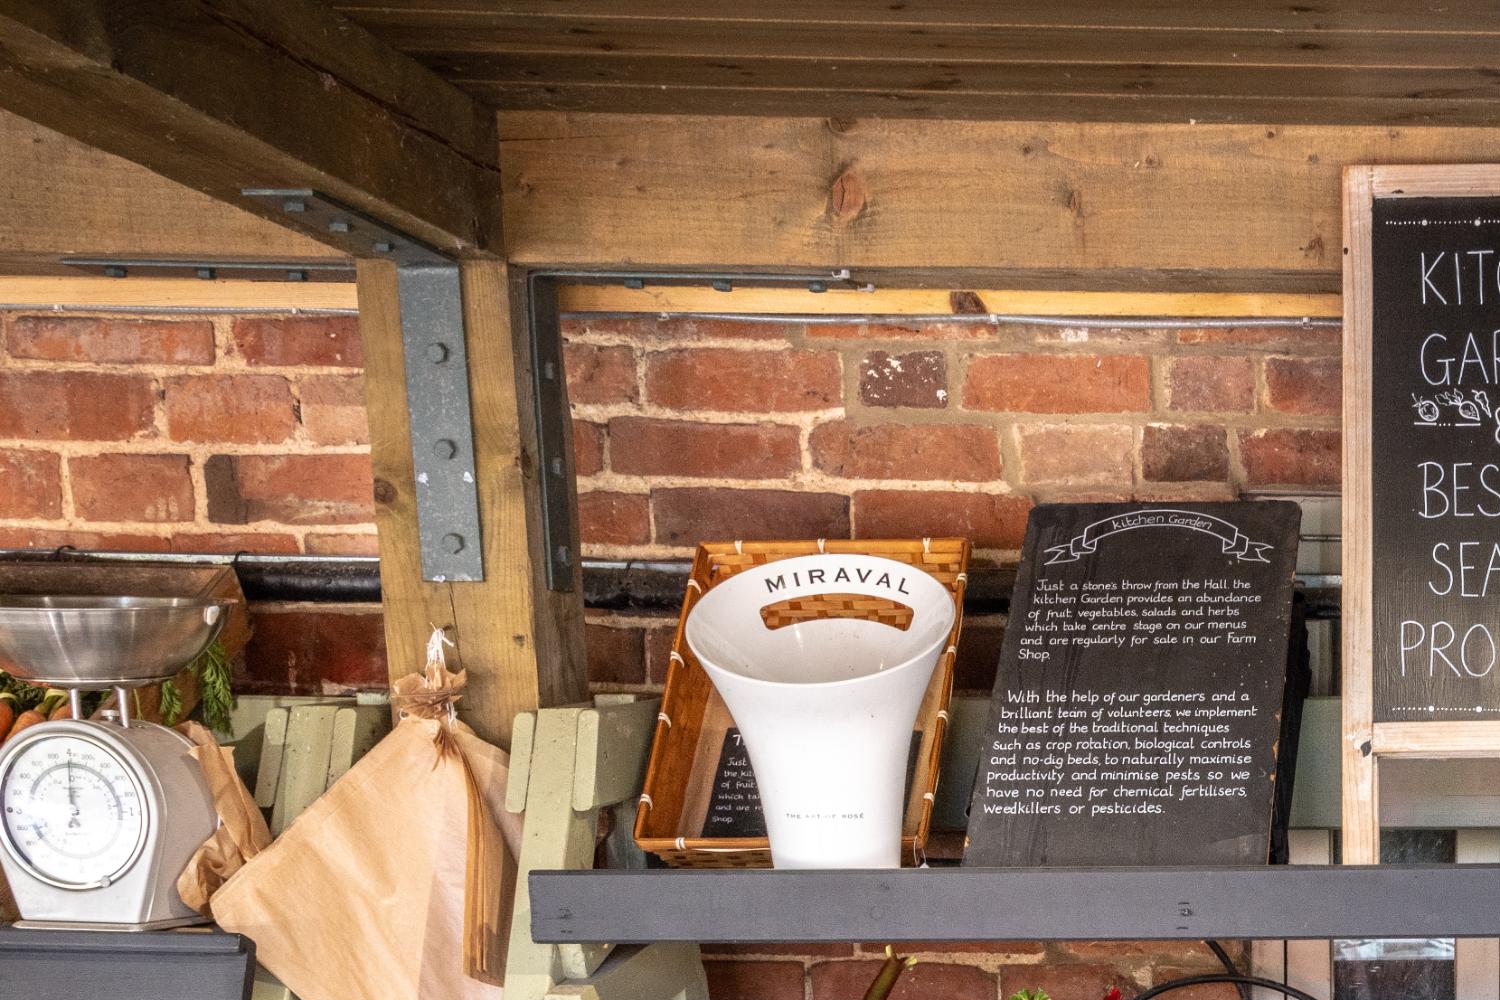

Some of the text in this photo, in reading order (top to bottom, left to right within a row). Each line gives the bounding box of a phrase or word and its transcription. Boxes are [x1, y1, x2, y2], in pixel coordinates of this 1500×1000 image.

[1168, 514, 1213, 530] Garden
[764, 567, 910, 595] MIRAVAL
[1036, 579, 1065, 591] Just
[1069, 583, 1079, 591] a
[1082, 581, 1117, 591] stone's
[1121, 579, 1152, 590] throw
[1154, 580, 1178, 592] from
[1182, 579, 1200, 590] the
[1233, 579, 1251, 589] the
[1080, 593, 1123, 604] Garden
[1126, 592, 1173, 606] provides
[1177, 595, 1192, 603] an
[1195, 592, 1262, 603] abundance
[1028, 610, 1040, 621] of
[1181, 606, 1203, 616] and
[1208, 605, 1240, 616] herbs
[1025, 620, 1247, 633] which take centre stage on our menus
[1020, 632, 1256, 648] and are regularly for sale in our Farm
[1007, 689, 1250, 706] With the help of our gardeners and a
[1001, 706, 1053, 719] brilliant
[1058, 707, 1087, 718] team
[1092, 708, 1104, 722] of
[1176, 709, 1192, 717] we
[1195, 705, 1259, 720] implement
[998, 721, 1230, 737] the best of the traditional techniques
[1025, 742, 1041, 750] as
[1045, 742, 1072, 753] crop
[1135, 737, 1194, 753] biological
[1201, 737, 1252, 749] controls
[727, 757, 747, 766] Just
[990, 753, 1252, 769] and no-dig beds, to naturally maximise
[986, 768, 1250, 784] productivity and minimise pests so we
[721, 781, 730, 789] of
[986, 784, 1248, 801] have no need for chemical fertilisers,
[1068, 805, 1085, 814] or
[1091, 801, 1166, 817] pesticides.
